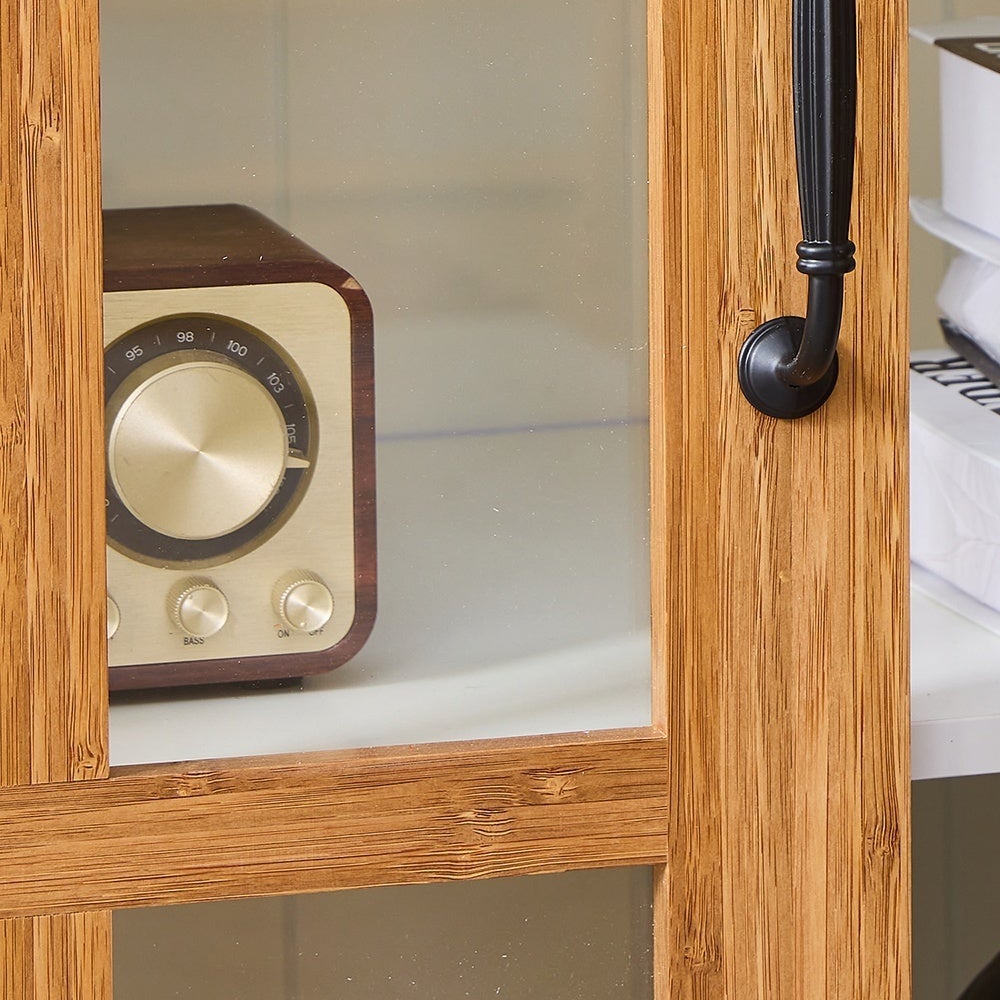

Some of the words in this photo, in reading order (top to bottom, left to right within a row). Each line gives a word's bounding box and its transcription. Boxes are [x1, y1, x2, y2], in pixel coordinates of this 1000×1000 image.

[124, 345, 144, 362] 95
[176, 331, 195, 344] 98
[226, 339, 248, 357] 100
[266, 372, 285, 394] 103
[277, 629, 290, 639] ON
[183, 636, 205, 646] BASS
